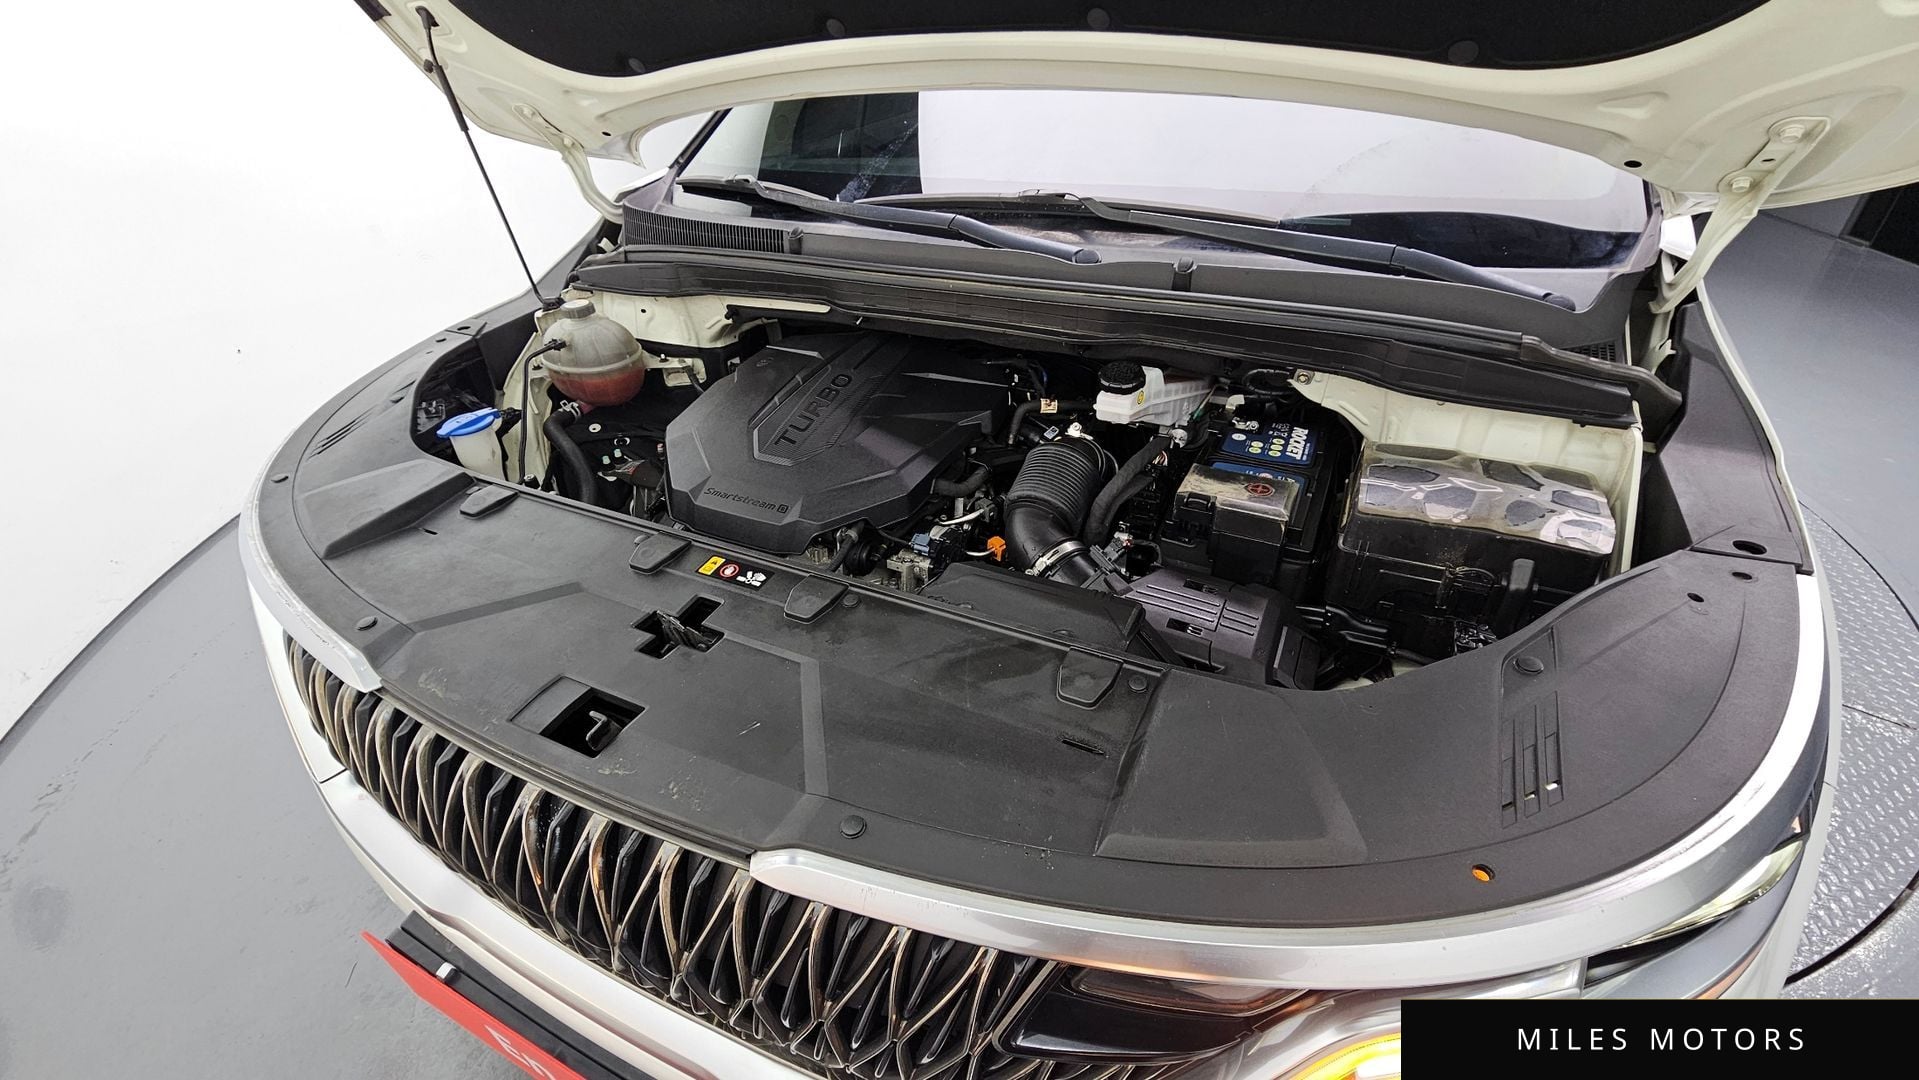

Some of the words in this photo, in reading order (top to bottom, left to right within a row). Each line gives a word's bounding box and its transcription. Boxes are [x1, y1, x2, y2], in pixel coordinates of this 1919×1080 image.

[774, 373, 852, 446] TURBO
[1285, 426, 1309, 460] ROCKET
[703, 487, 777, 510] Smartstream
